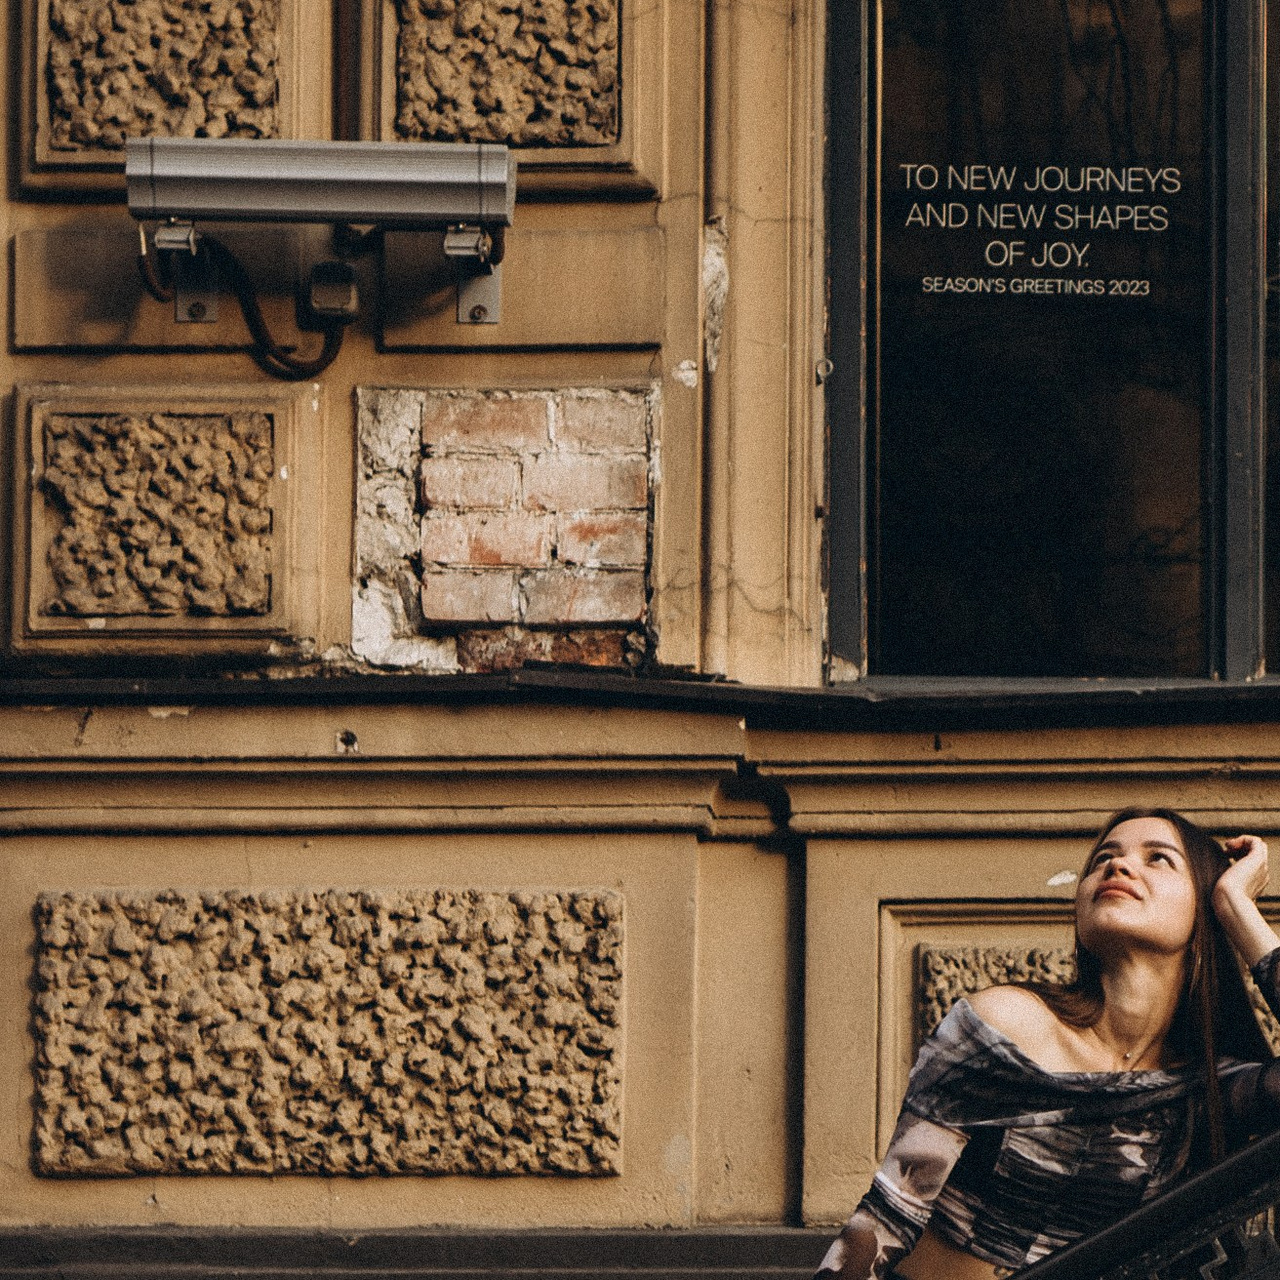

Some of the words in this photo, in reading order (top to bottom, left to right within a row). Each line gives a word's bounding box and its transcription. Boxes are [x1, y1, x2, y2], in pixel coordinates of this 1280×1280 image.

[899, 163, 939, 191] TO
[947, 164, 1018, 191] NEW
[1023, 165, 1182, 194] JOURNEYS
[904, 202, 969, 228] AND
[977, 203, 1047, 229] NEW
[1054, 203, 1170, 232] SHAPES
[984, 240, 1026, 267] OF
[1031, 241, 1091, 269] JOY.
[922, 276, 1007, 294] SEASON'S
[1009, 277, 1106, 296] GREETINGS
[1108, 279, 1151, 296] 2023
